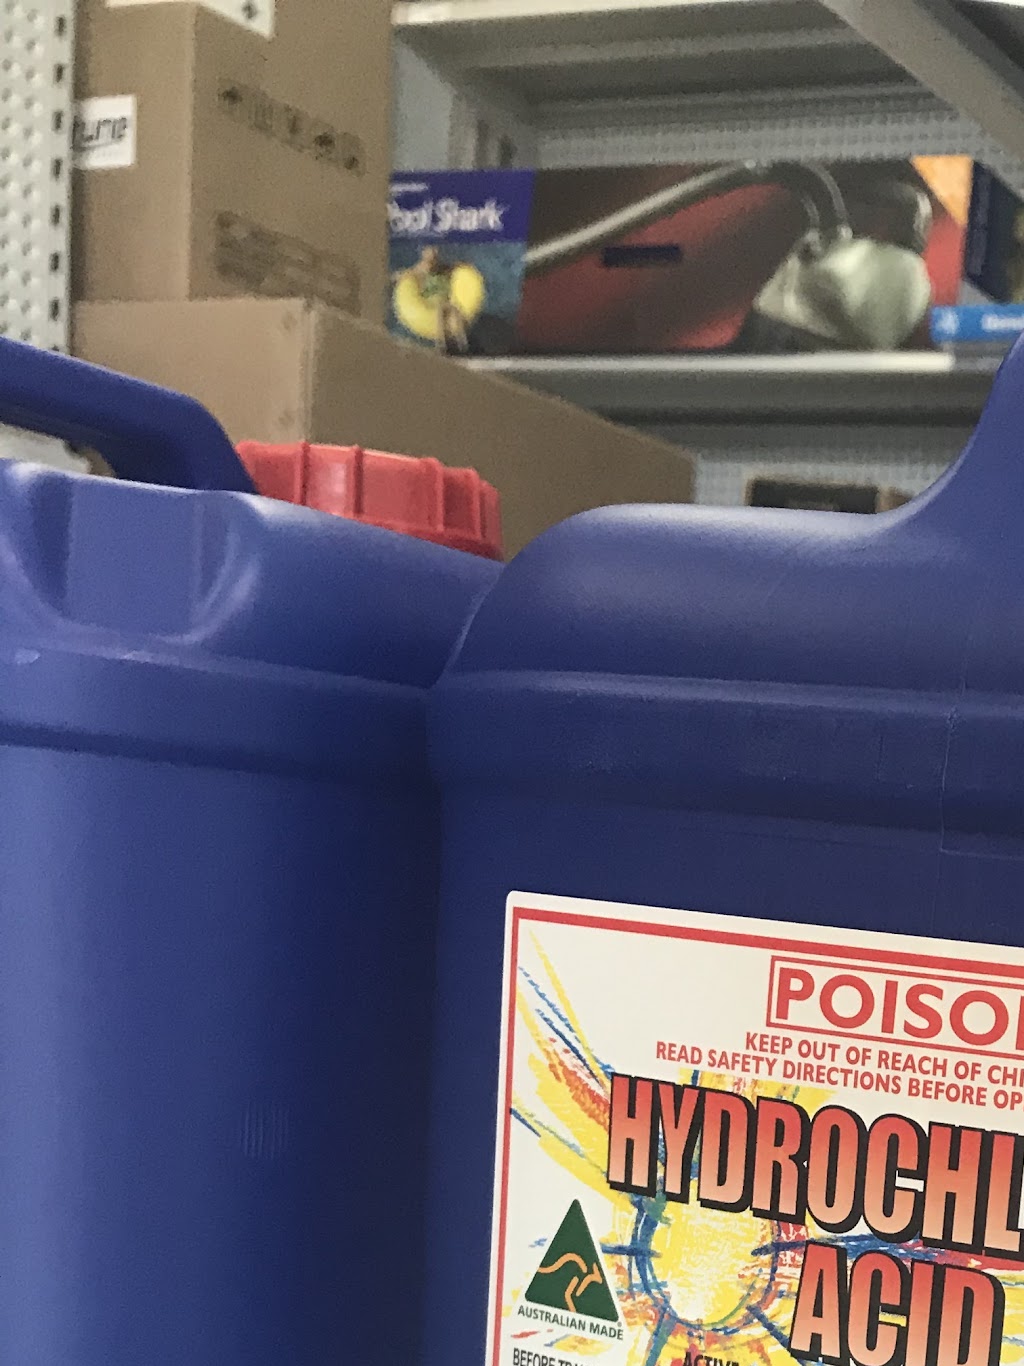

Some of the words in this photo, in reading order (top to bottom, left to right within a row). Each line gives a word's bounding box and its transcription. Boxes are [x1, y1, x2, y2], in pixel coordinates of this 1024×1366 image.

[656, 1041, 703, 1065] READ
[707, 1049, 778, 1076] SAFETY
[783, 1060, 902, 1095] DIRECTIONS
[907, 1077, 988, 1107] BEFORE
[745, 1031, 793, 1055] KEEP
[797, 1039, 841, 1062] OUT
[845, 1046, 872, 1067] OF
[877, 1050, 948, 1078] REACH
[954, 1060, 982, 1082] OF
[517, 1305, 586, 1332] AUSTRALIAN
